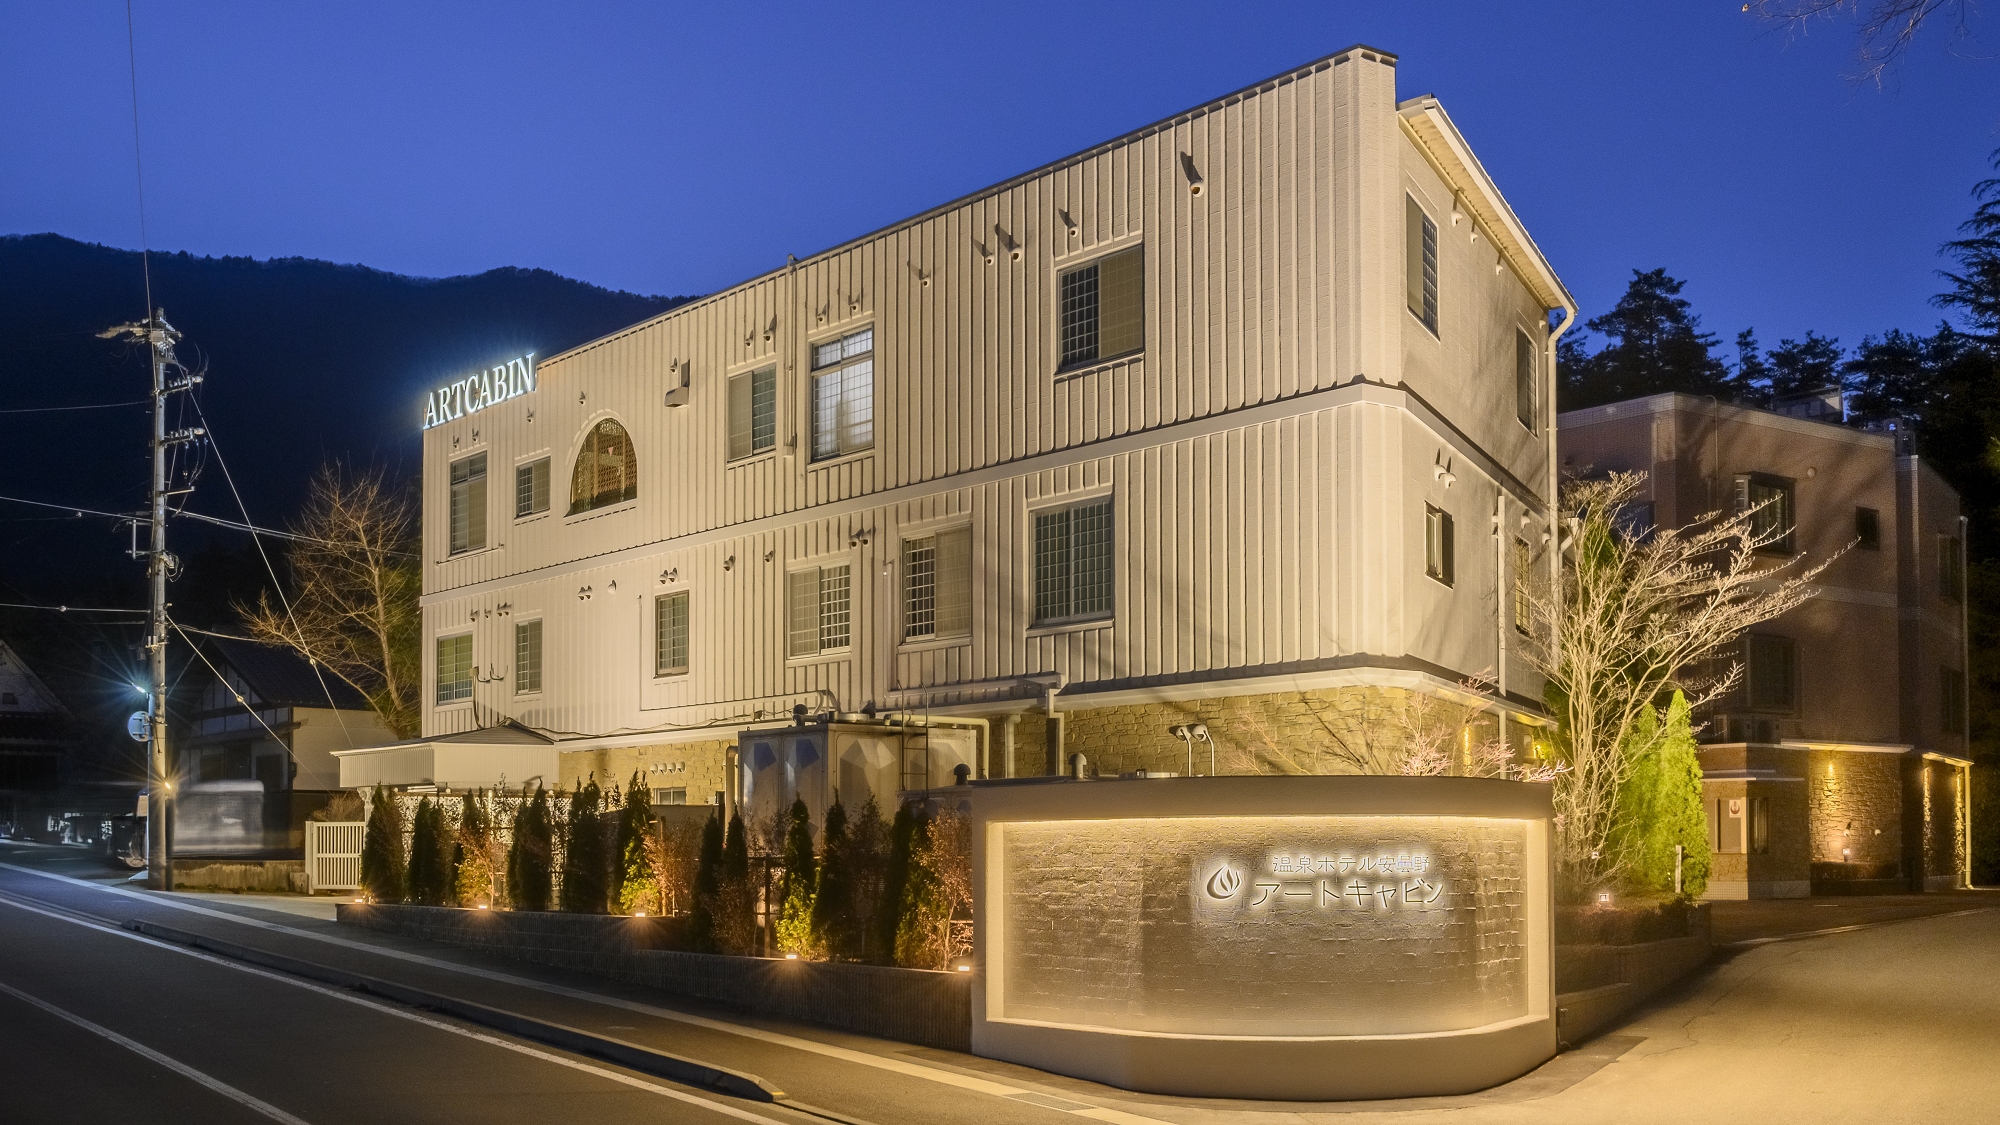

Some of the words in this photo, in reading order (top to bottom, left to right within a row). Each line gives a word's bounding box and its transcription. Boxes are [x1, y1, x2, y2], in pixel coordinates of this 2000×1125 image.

[423, 352, 536, 430] ARTCABIN
[1272, 855, 1430, 873] 温泉ホテル安曇野
[1252, 878, 1443, 908] アートキャビン
